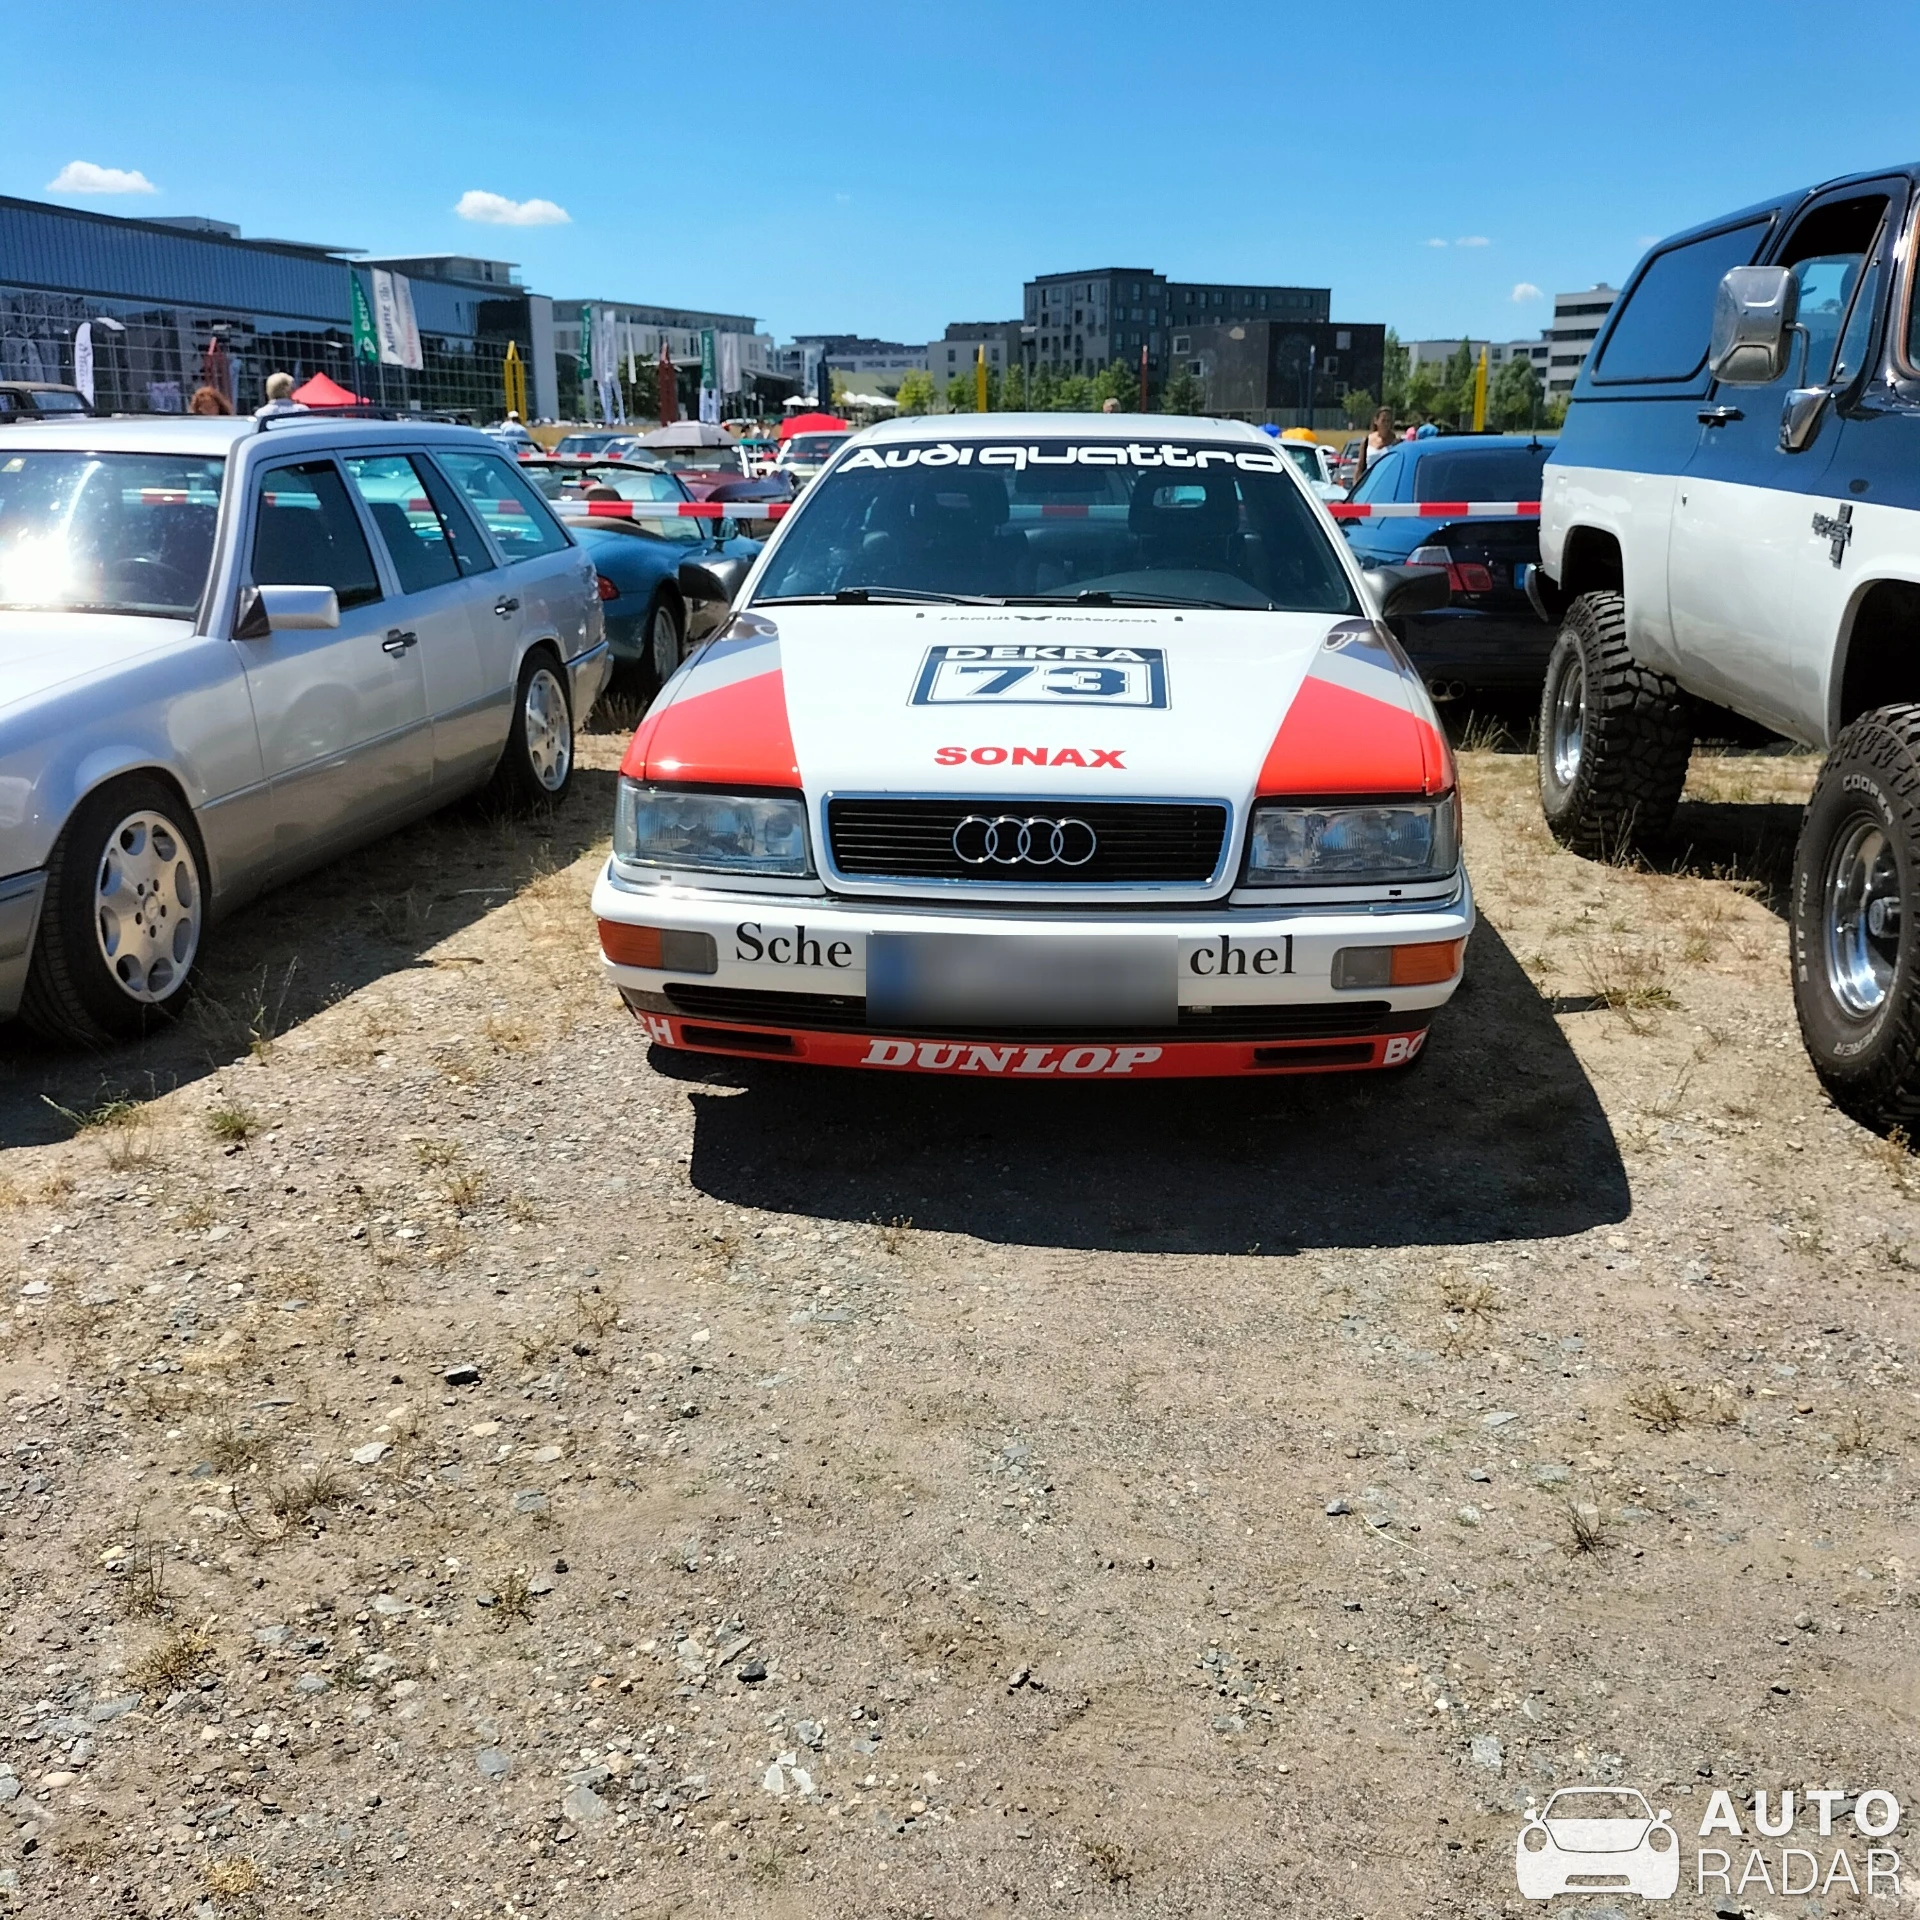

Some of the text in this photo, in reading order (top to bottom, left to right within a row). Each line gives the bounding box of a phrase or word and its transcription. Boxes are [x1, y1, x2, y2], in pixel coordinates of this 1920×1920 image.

[978, 443, 1284, 474] quattro
[944, 646, 1146, 662] DEKRA
[955, 665, 1130, 697] 73
[934, 746, 1128, 769] SONAX
[736, 921, 853, 968] Sche
[1190, 934, 1297, 975] chel
[861, 1040, 1163, 1074] DUNLOP
